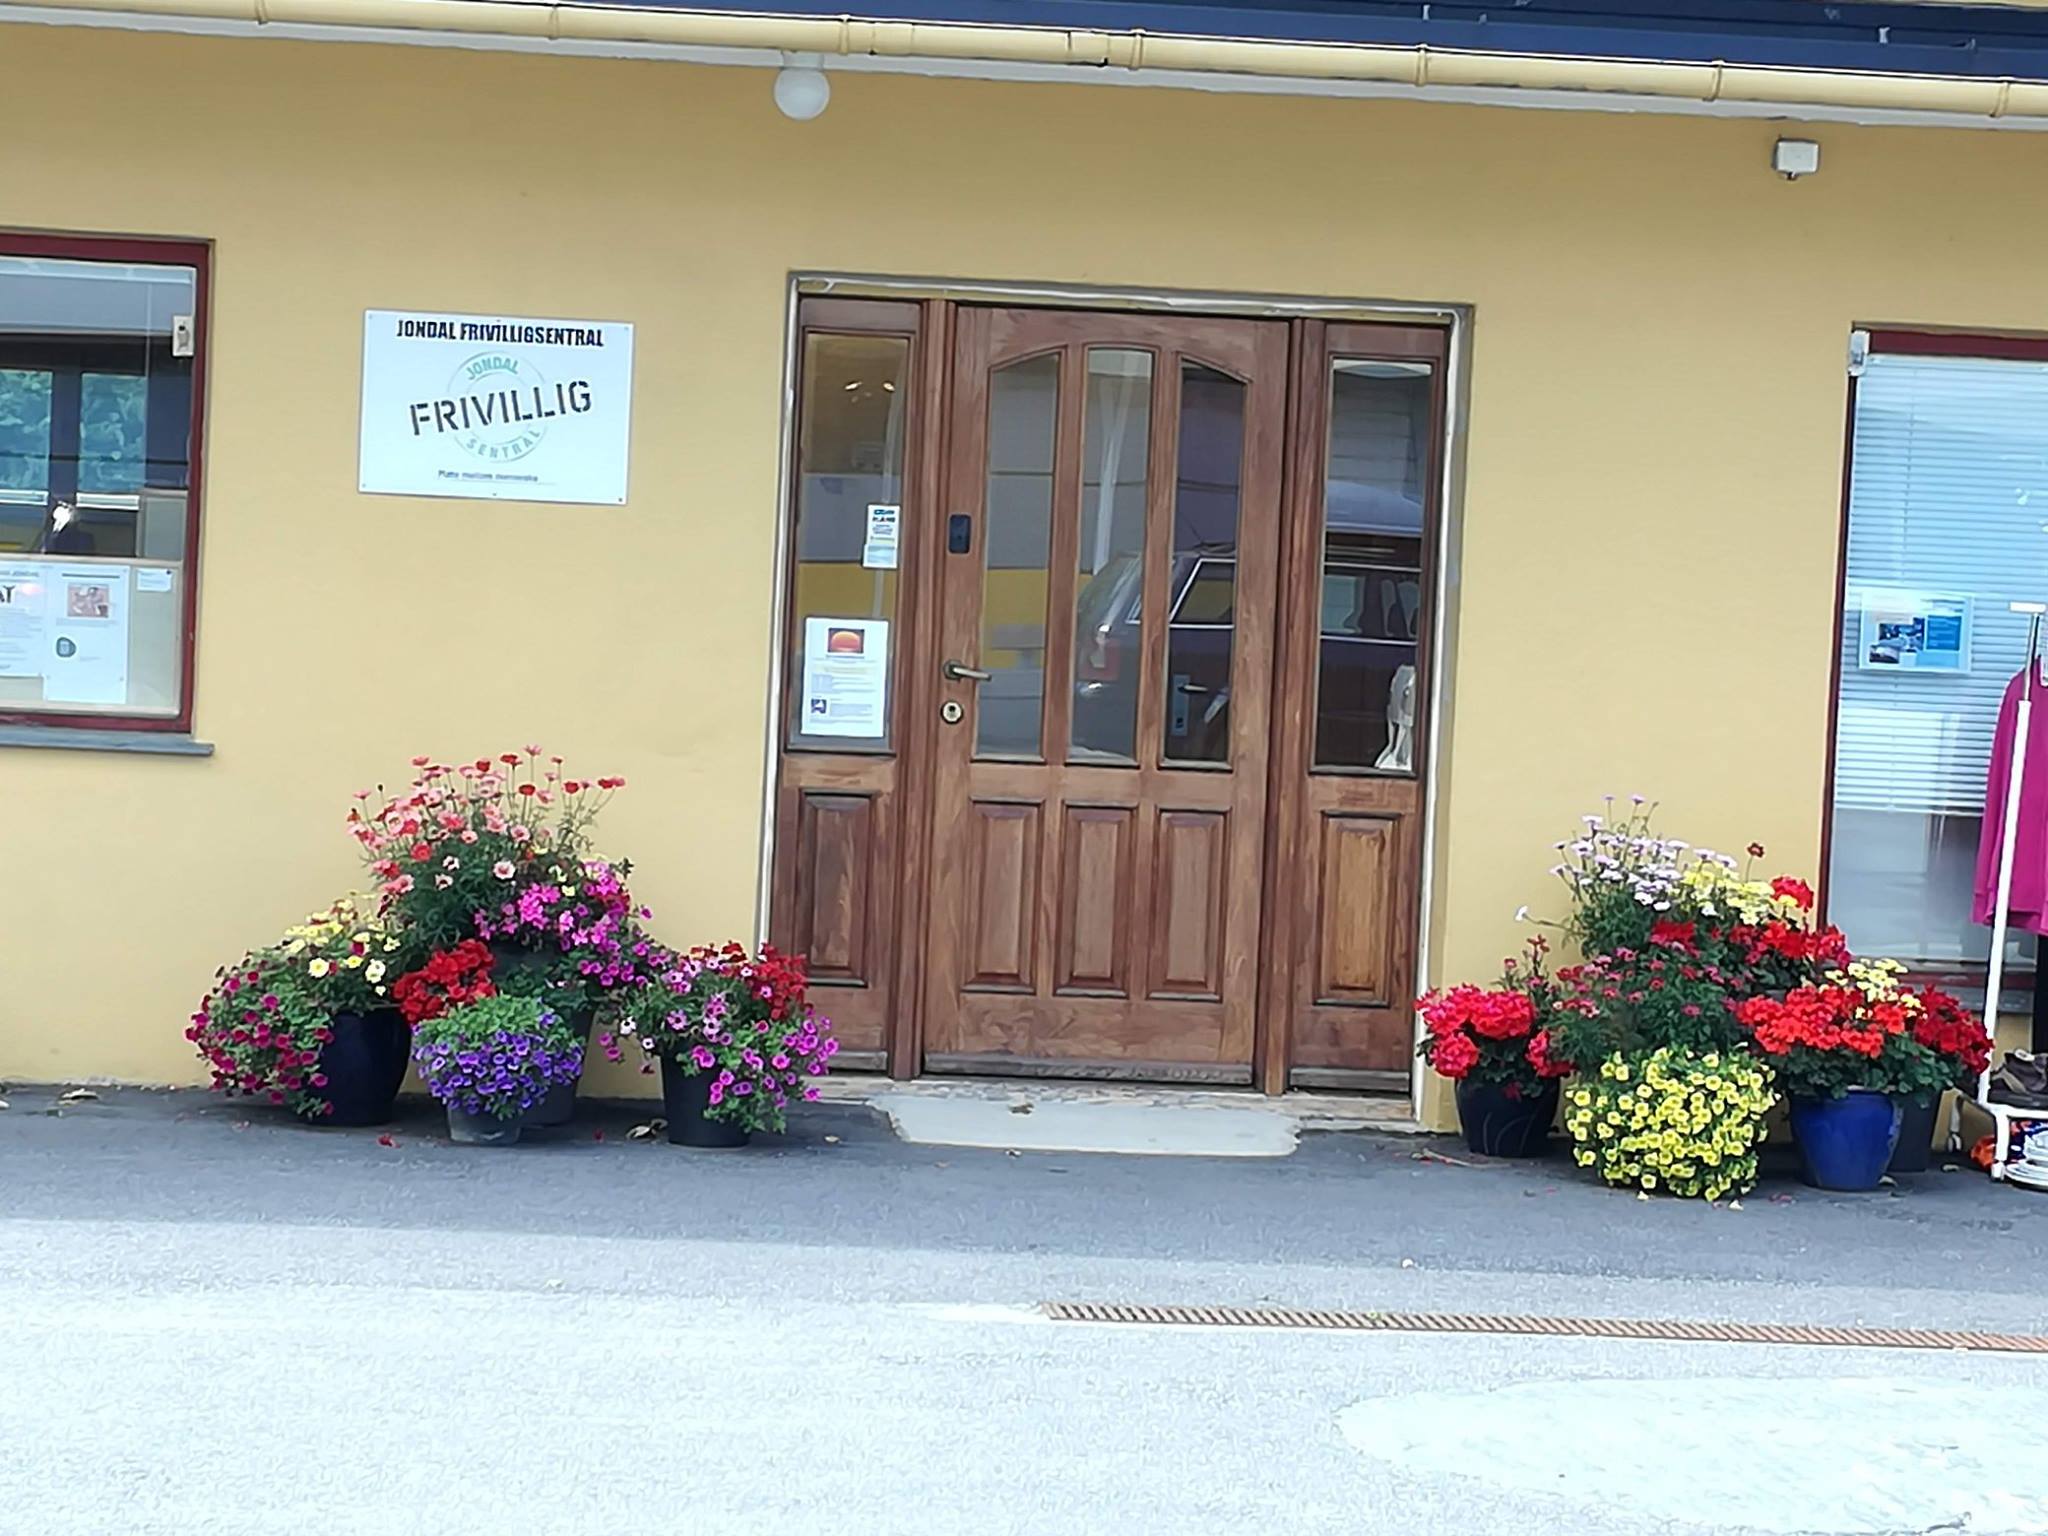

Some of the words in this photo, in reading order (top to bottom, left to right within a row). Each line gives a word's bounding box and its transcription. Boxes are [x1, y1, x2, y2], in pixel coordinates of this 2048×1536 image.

[397, 319, 457, 341] JONDAL
[459, 322, 604, 347] FRIVILLIGSENTRAL
[466, 356, 519, 381] JONDAL
[409, 380, 592, 436] FRIVILLIG
[465, 429, 541, 459] SENTRAL
